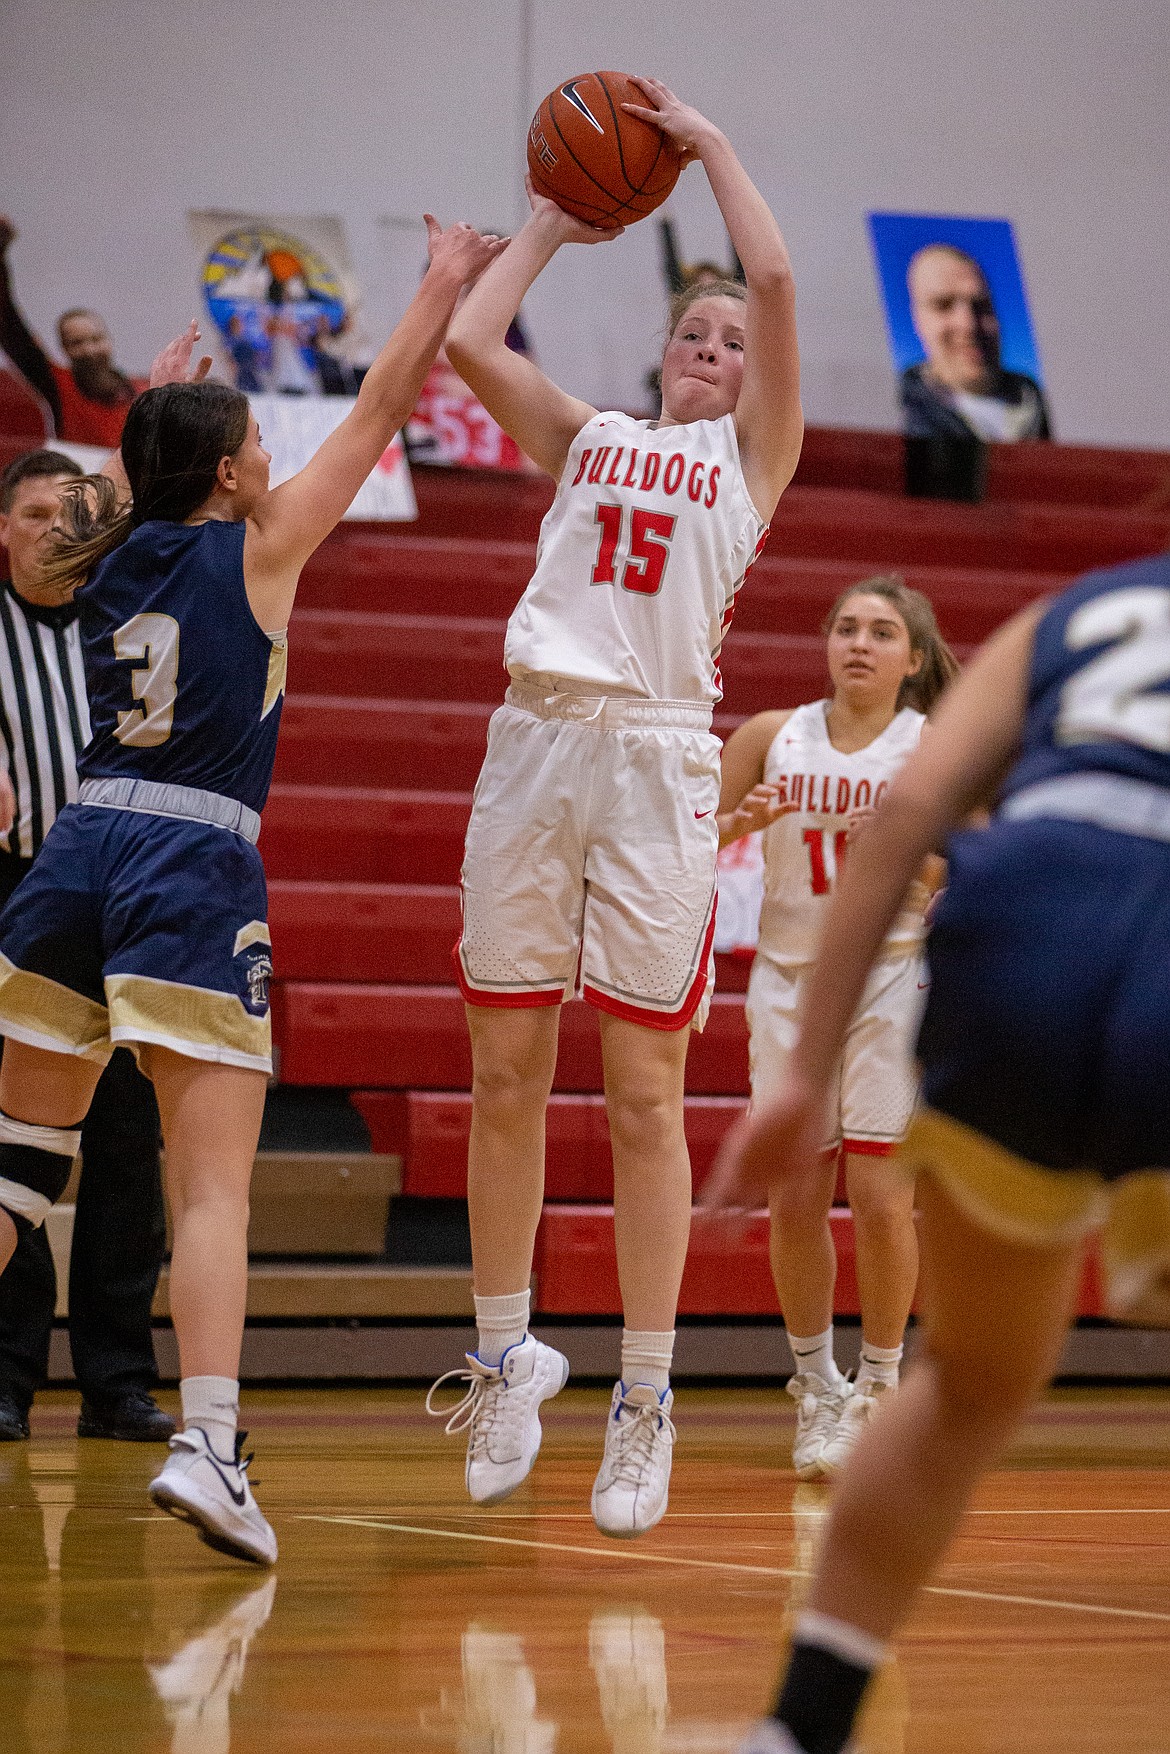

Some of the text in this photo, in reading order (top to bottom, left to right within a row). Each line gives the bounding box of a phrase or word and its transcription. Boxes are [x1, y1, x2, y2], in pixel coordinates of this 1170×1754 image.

[571, 446, 721, 510] BULLDOGS
[590, 501, 679, 597] 15
[112, 612, 180, 748] 3
